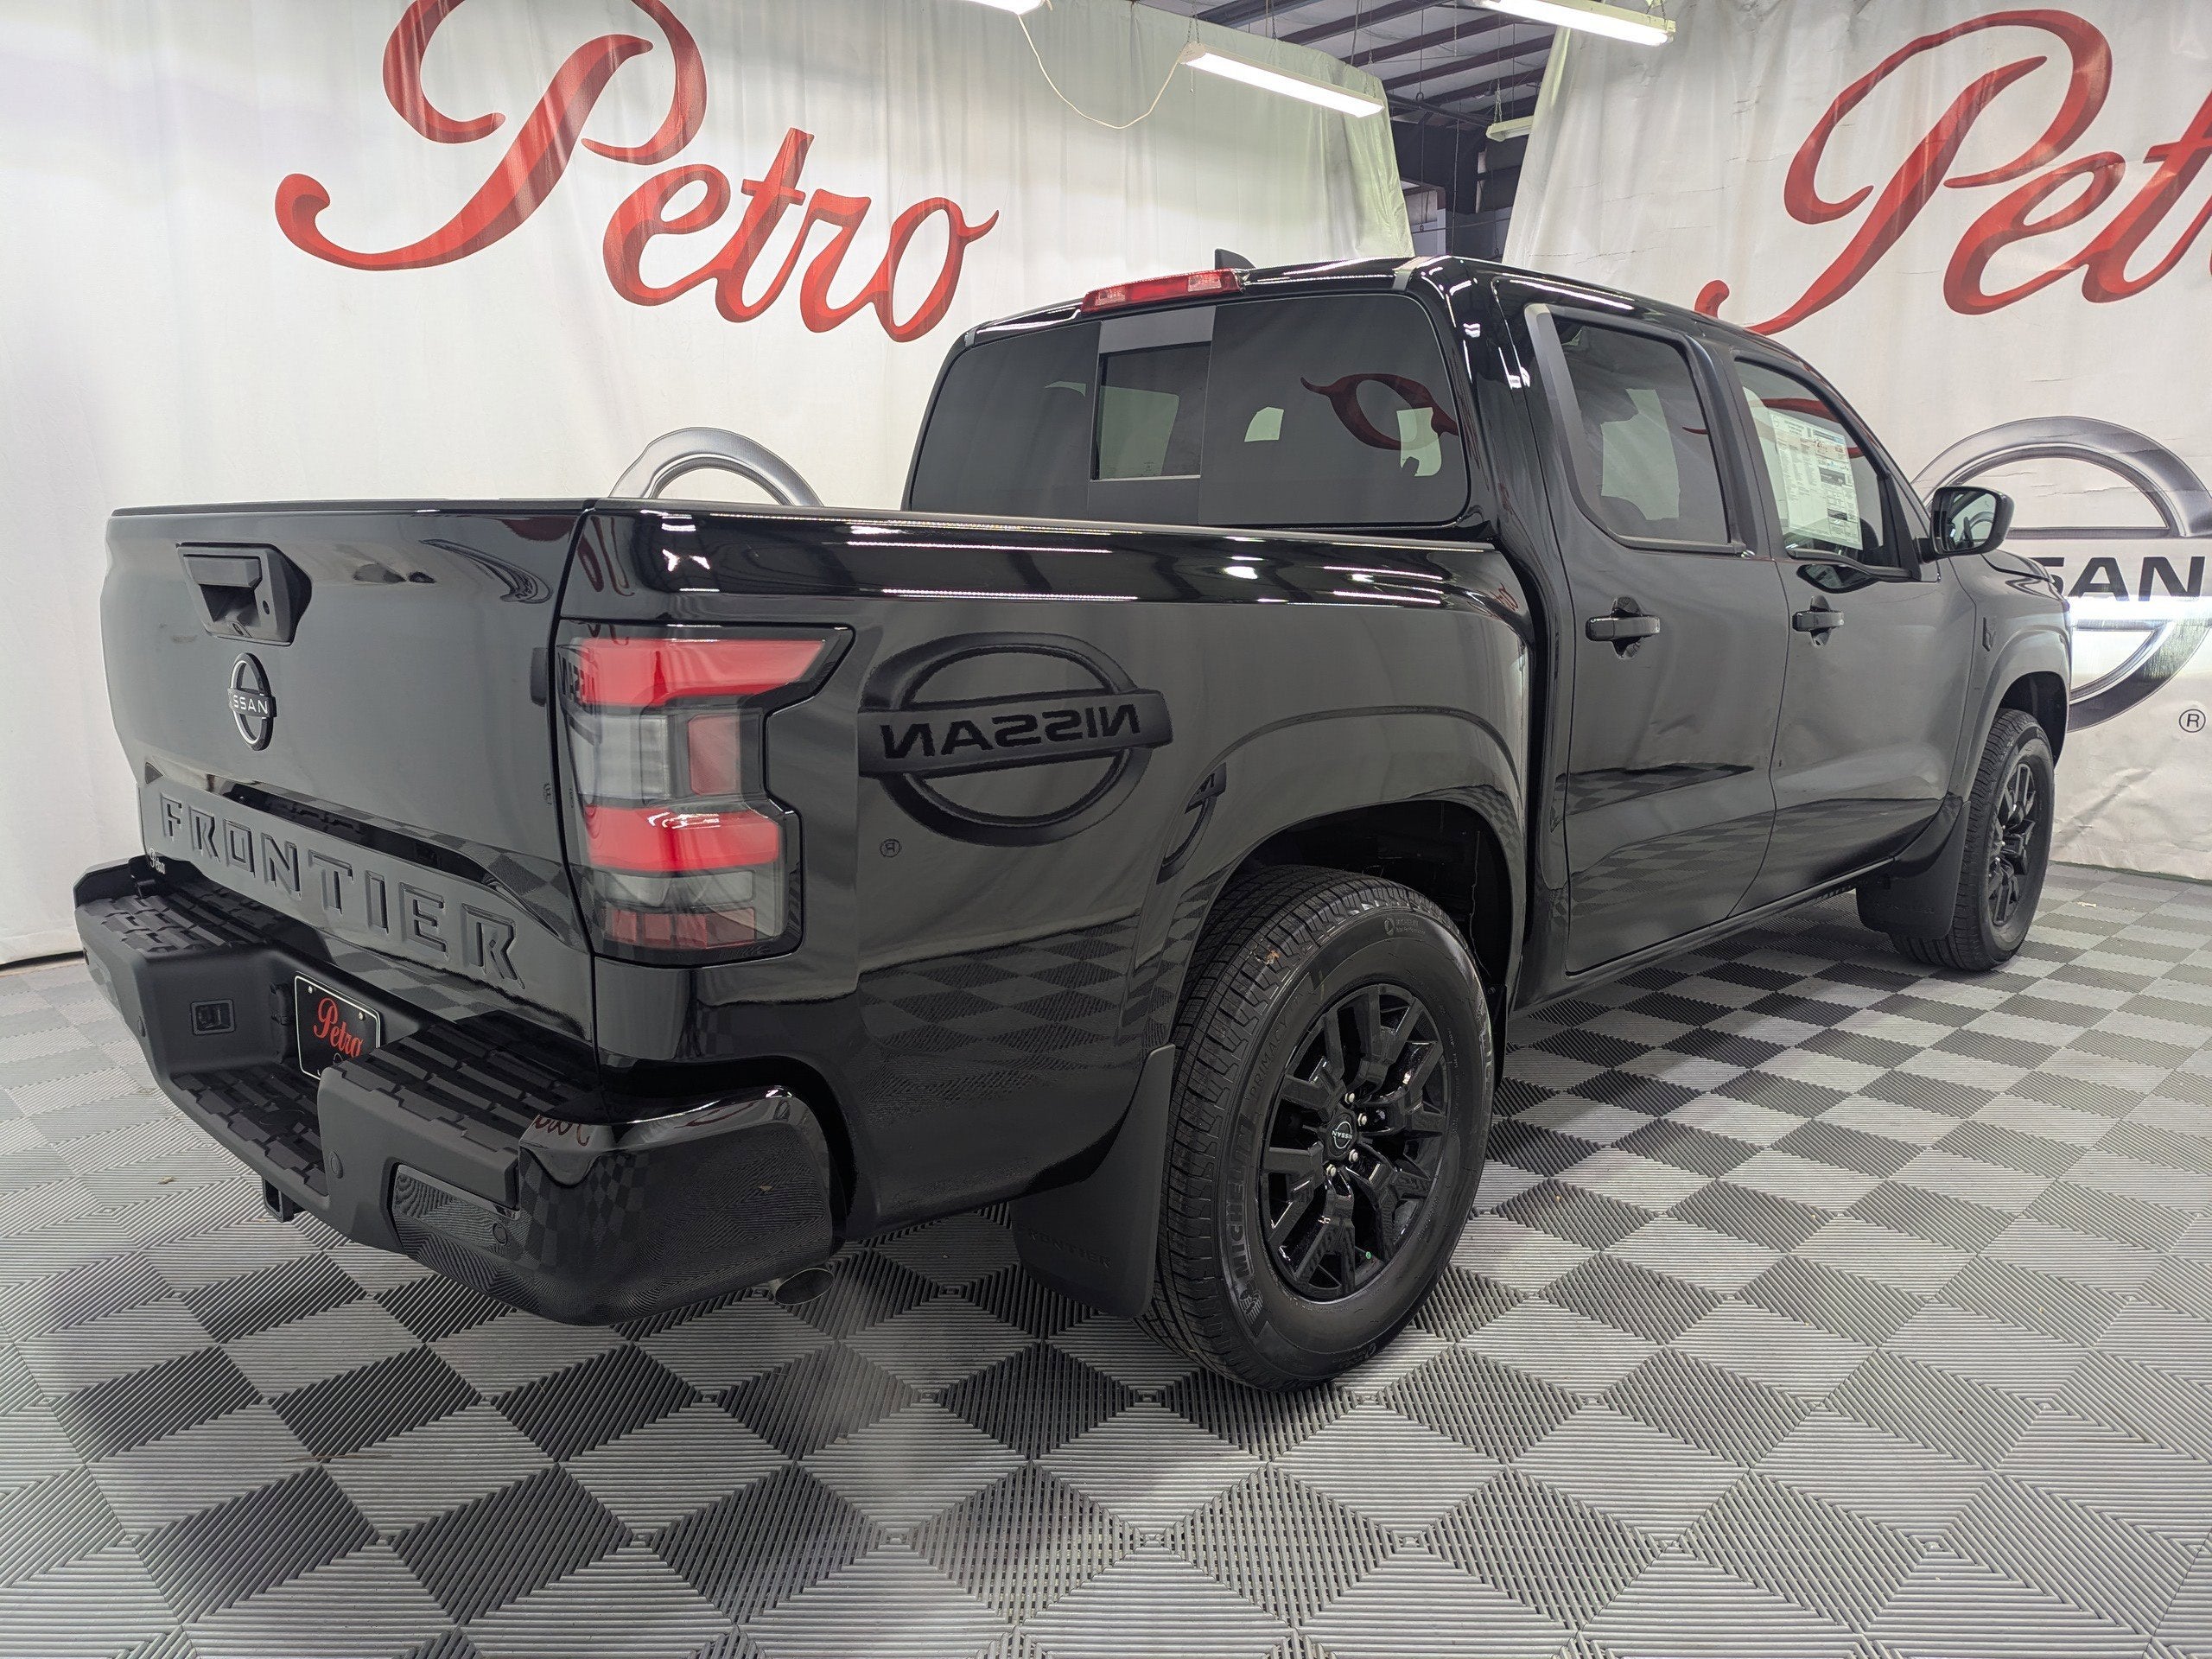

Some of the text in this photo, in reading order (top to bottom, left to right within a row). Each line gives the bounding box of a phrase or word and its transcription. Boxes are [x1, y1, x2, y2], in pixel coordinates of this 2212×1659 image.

[274, 0, 999, 343] Petro
[1694, 9, 2212, 336] Pet
[160, 791, 525, 990] FRONTIER
[313, 997, 364, 1058] Petro
